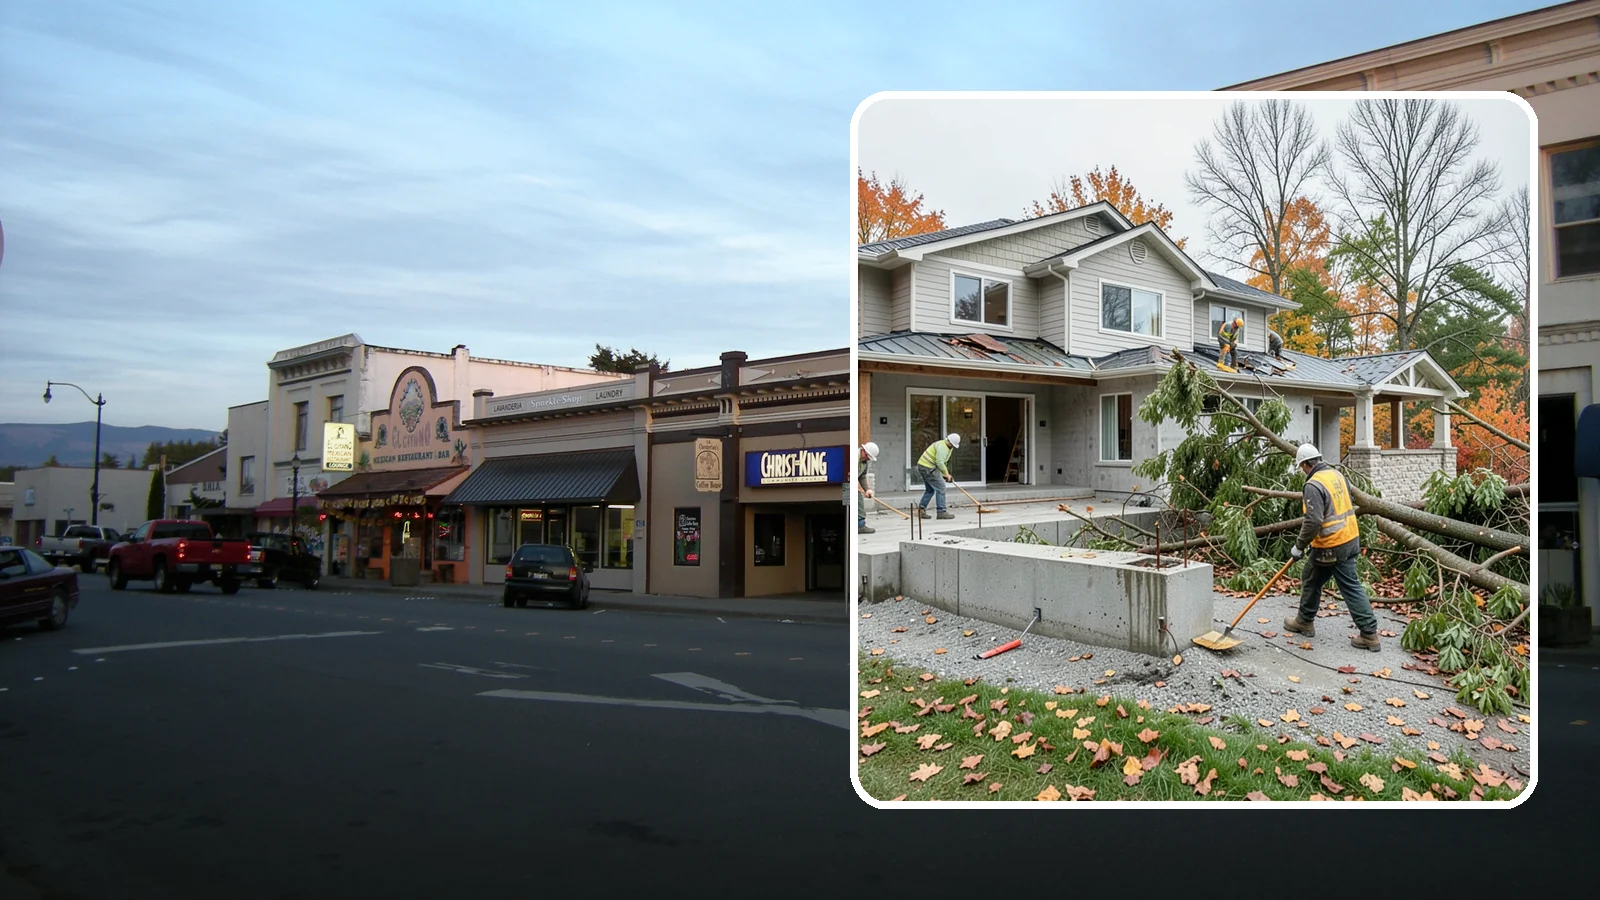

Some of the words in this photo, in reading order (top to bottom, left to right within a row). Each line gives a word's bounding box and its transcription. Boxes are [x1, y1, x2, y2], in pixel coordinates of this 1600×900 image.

[562, 394, 583, 405] Shop
[595, 389, 623, 400] LAUNDRY
[493, 402, 522, 412] LAVANDERIA
[373, 455, 396, 464] MEXICAN
[398, 451, 433, 462] RESTAURANT
[438, 450, 450, 459] BAR
[761, 452, 797, 477] CHRIST
[799, 450, 827, 476] KING
[696, 480, 709, 489] Coffee
[710, 481, 721, 489] House
